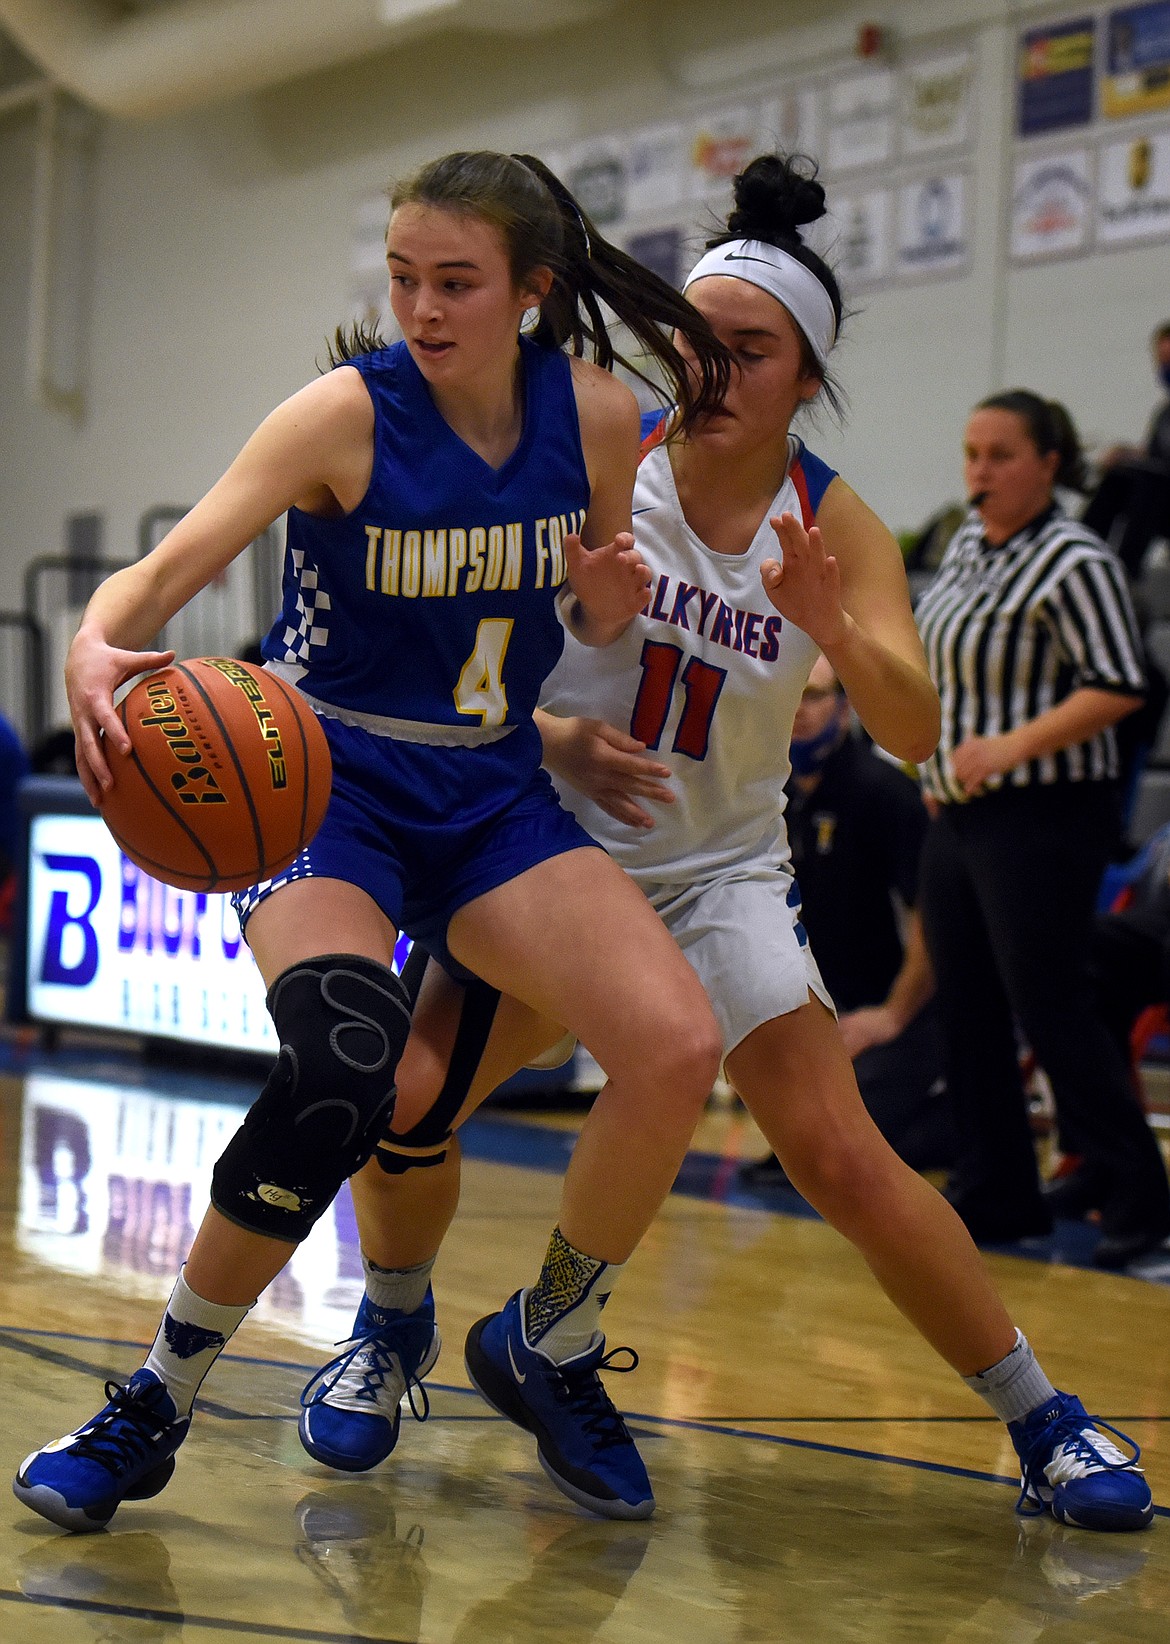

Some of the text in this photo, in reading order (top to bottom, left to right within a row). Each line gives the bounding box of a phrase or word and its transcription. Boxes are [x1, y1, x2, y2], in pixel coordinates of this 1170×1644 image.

[365, 508, 586, 598] THOMPSON FAL
[453, 618, 514, 727] 4
[640, 574, 782, 662] LKYRIES
[140, 680, 229, 804] Baden
[630, 639, 728, 762] 11
